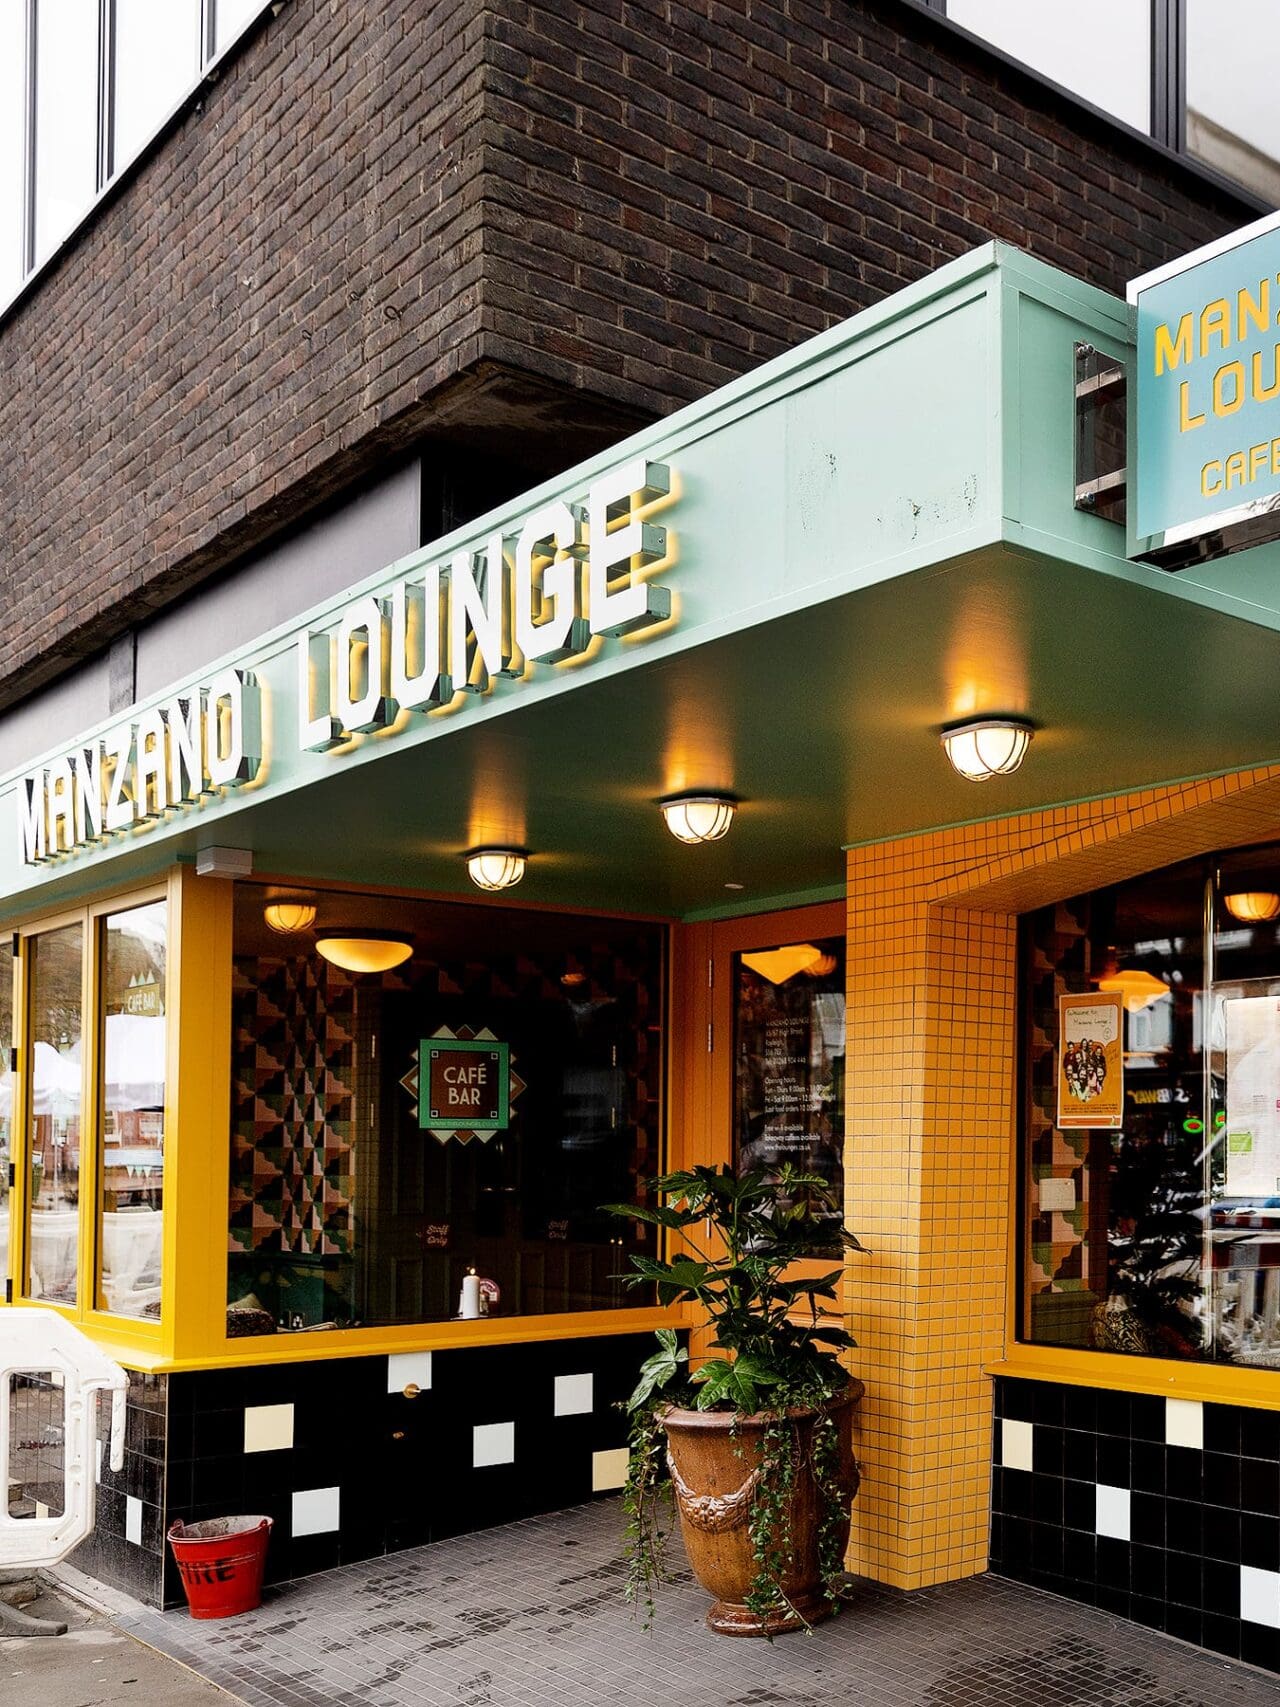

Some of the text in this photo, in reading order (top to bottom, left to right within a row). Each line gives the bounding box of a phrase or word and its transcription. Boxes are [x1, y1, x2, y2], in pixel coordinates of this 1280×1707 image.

[16, 458, 671, 866] MANZANO LOUNGE
[443, 1063, 488, 1085] CAFÉ
[448, 1087, 481, 1105] BAR
